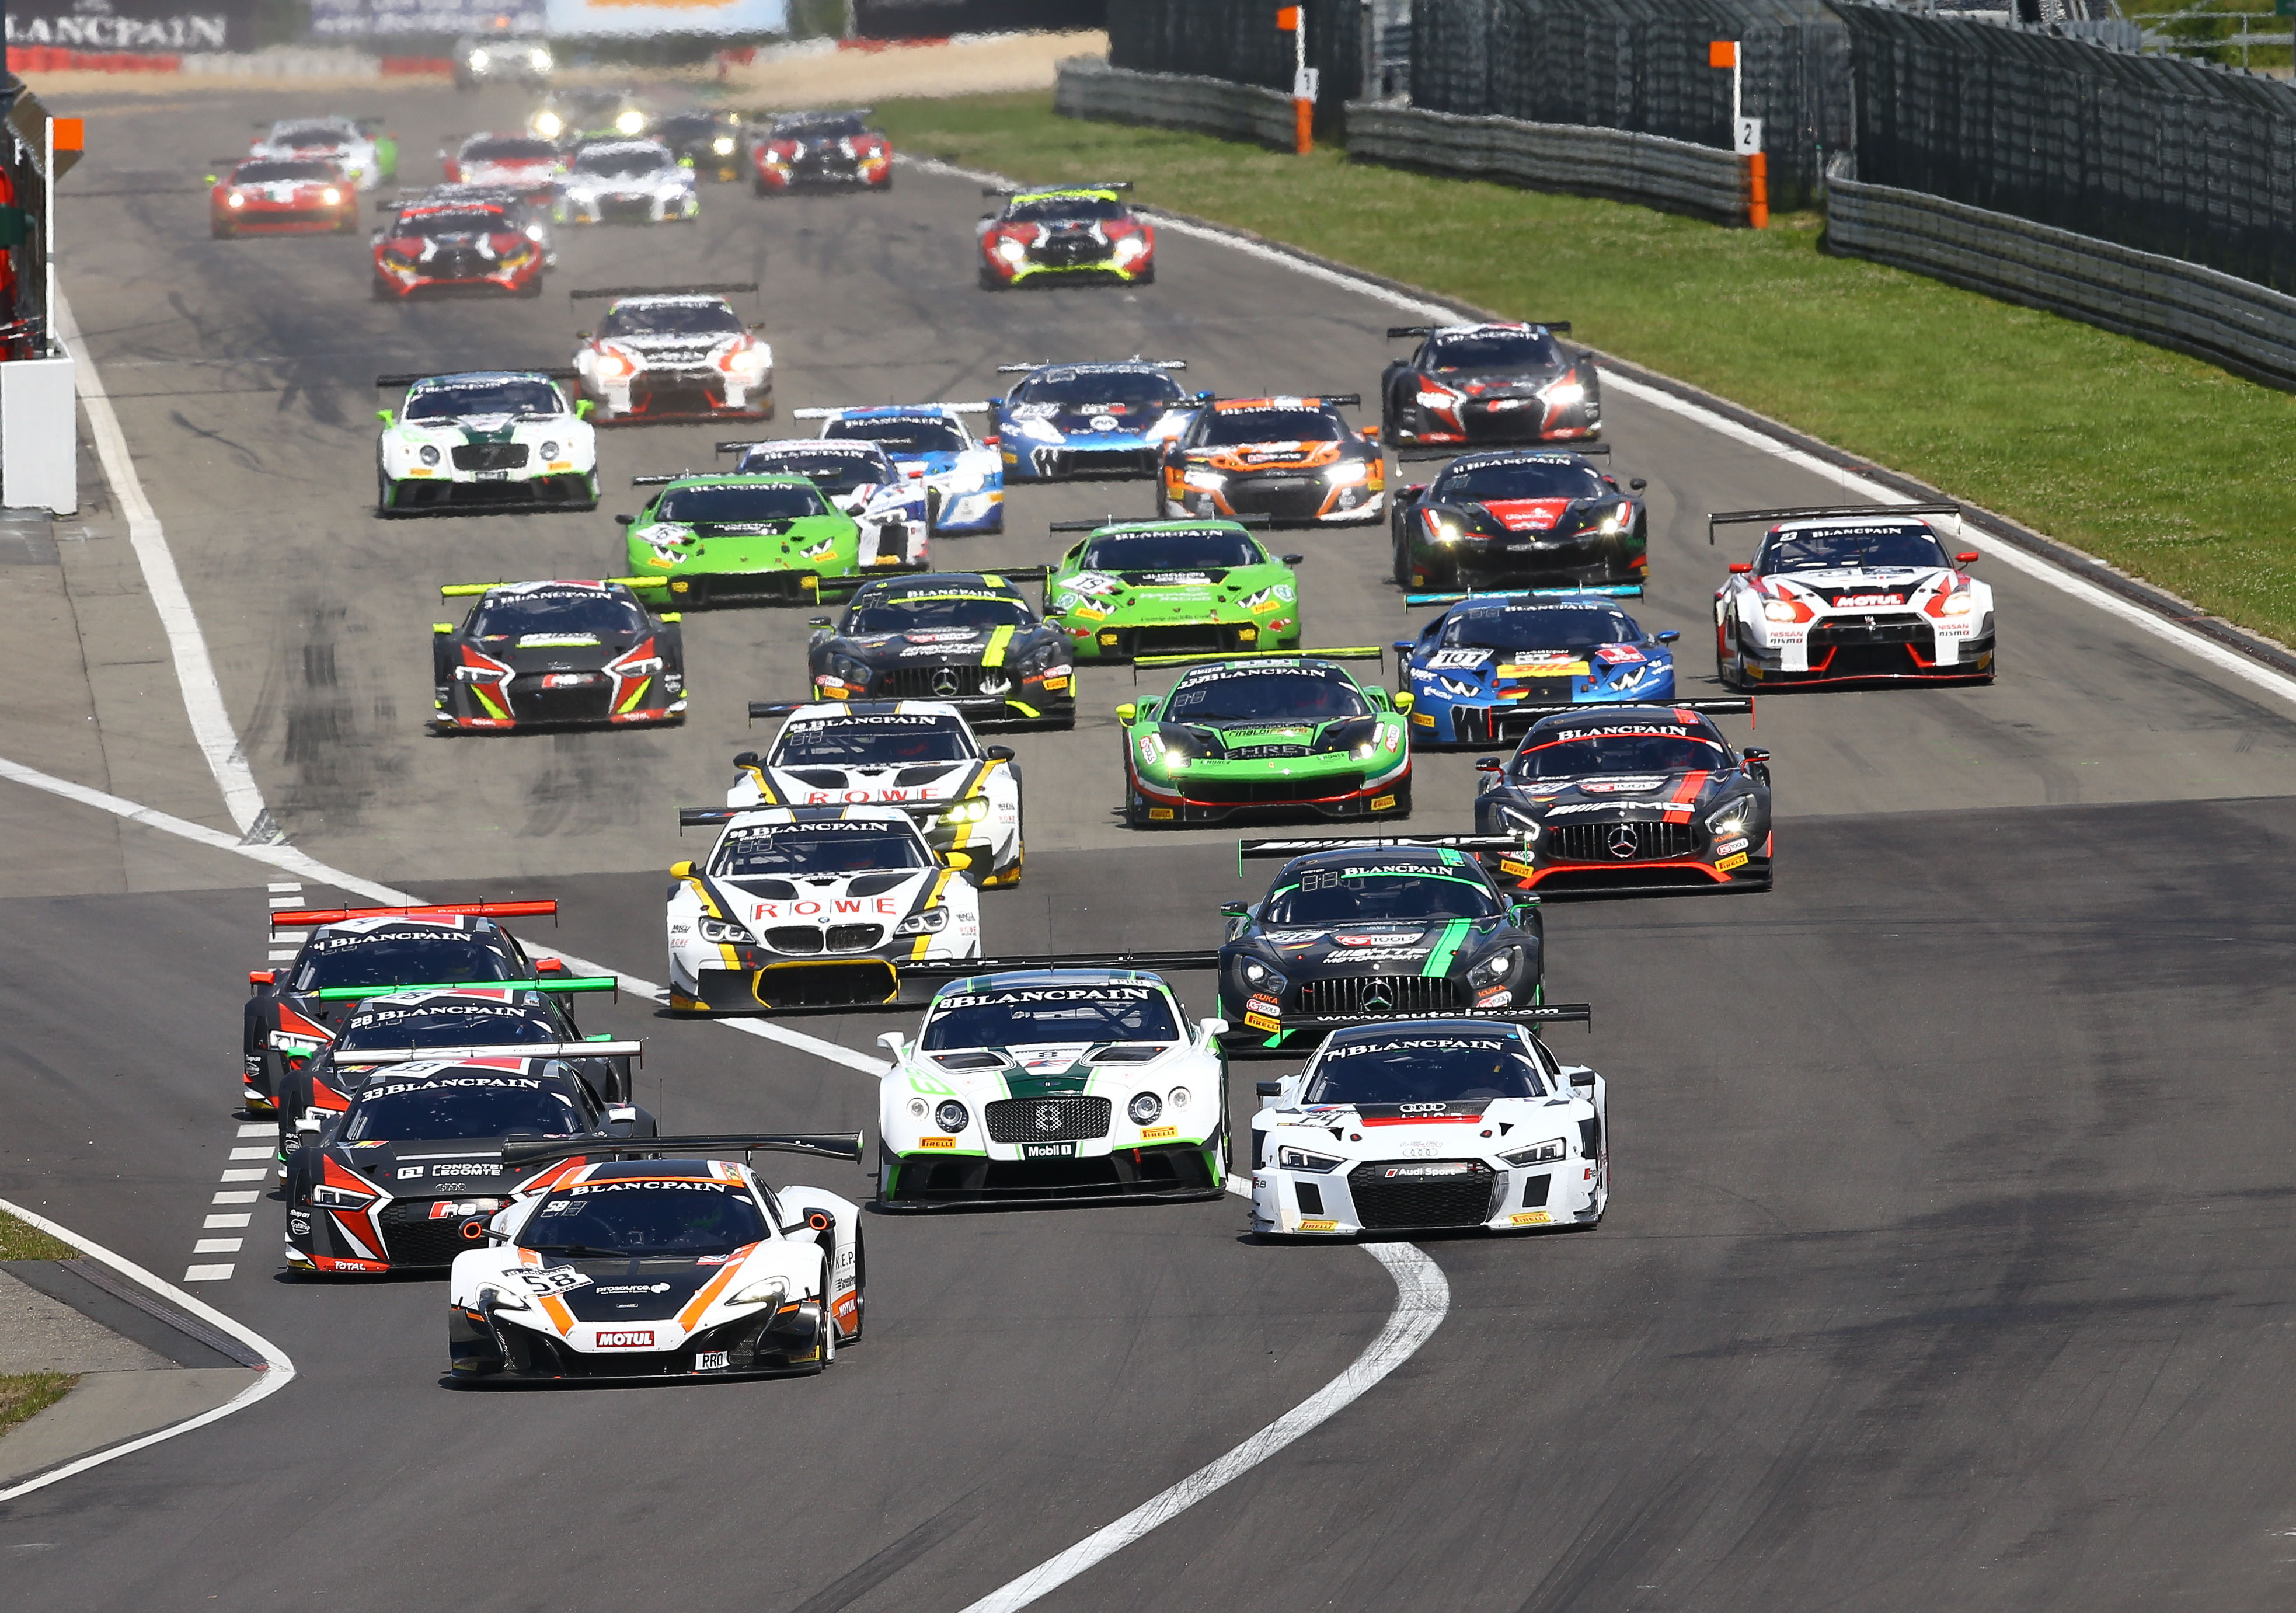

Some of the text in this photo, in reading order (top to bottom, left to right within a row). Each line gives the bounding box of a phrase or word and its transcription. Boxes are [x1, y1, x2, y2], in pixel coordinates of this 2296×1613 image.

[5, 15, 226, 47] LANCPAIN
[1744, 124, 1752, 145] 2
[1779, 528, 1902, 541] 23 BLANCPAIN
[1836, 594, 1902, 607] MOTUL
[1206, 668, 1326, 682] BLANCPAIN
[811, 715, 938, 729] BLANCPAIN
[1558, 726, 1688, 742] BLANCPAIN
[730, 822, 889, 839] 99 BLANCPAIN
[1730, 841, 1747, 852] TOOLS
[1721, 854, 1747, 870] PIRELLI
[1343, 865, 1454, 876] BLANCPAIN
[755, 897, 897, 921] ROWE
[314, 932, 472, 951] 4 BLANCPAIN
[1372, 935, 1417, 944] TOOLS
[1478, 985, 1506, 997] KUKA
[940, 988, 1150, 1009] 8 BLANCPAIN
[1253, 993, 1278, 1004] KUKA
[1259, 1004, 1280, 1015] TOOLS
[1318, 1008, 1559, 1022] www.auto-isr.com
[351, 1006, 527, 1029] 28 BLANCPAIN
[1250, 1016, 1280, 1031] PIRELLI
[1325, 1039, 1503, 1062] 74 BLANCPAIN
[361, 1078, 541, 1103] 33 BLANCPAIN
[1143, 1127, 1175, 1138] PIRELLI
[922, 1139, 954, 1148] PIRELLI
[1028, 1144, 1072, 1157] Mobil 1
[1398, 1168, 1455, 1177] Audi Sport
[570, 1182, 727, 1197] BLANCPAIN
[435, 1203, 476, 1218] R8
[543, 1200, 570, 1213] 58
[1301, 1221, 1335, 1229] PIRELLI
[1513, 1213, 1548, 1223] PIRELLI
[335, 1261, 366, 1271] TOTAL
[836, 1251, 855, 1270] K.E.P.
[525, 1273, 577, 1292] 58
[838, 1299, 856, 1318] MOTUL
[599, 1333, 653, 1346] MOTUL
[702, 1353, 724, 1368] PRO
